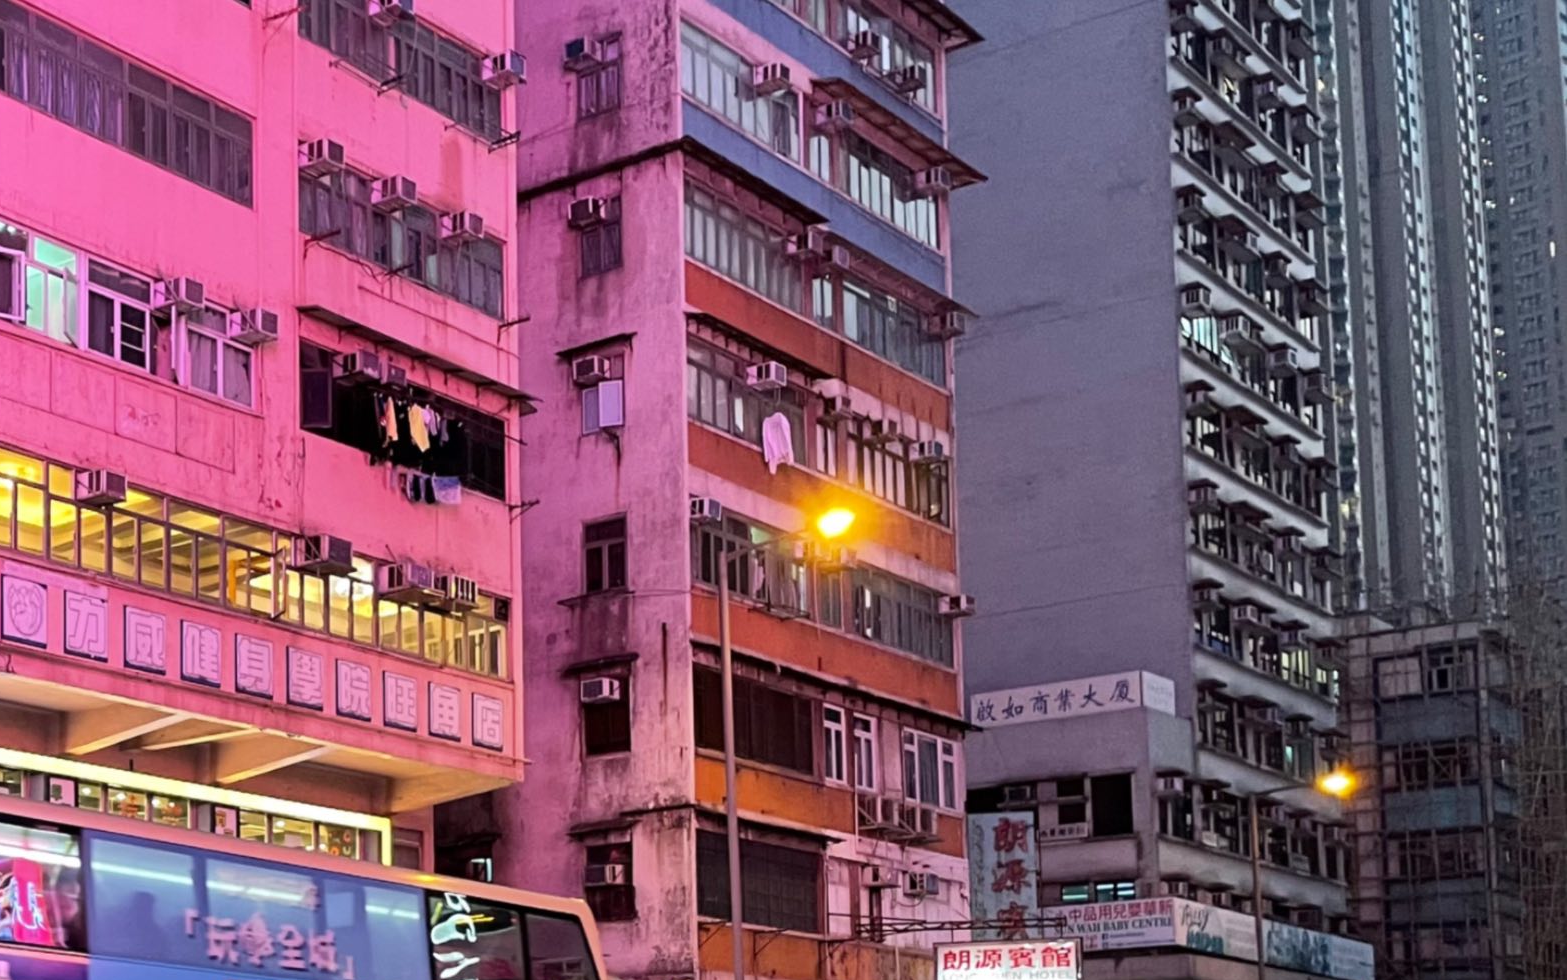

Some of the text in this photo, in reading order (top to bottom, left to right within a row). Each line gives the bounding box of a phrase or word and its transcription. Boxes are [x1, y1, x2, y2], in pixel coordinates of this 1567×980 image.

[1103, 920, 1130, 931] BABY
[943, 946, 1071, 971] 朗源賓館
[1029, 970, 1074, 980] HOTEL
